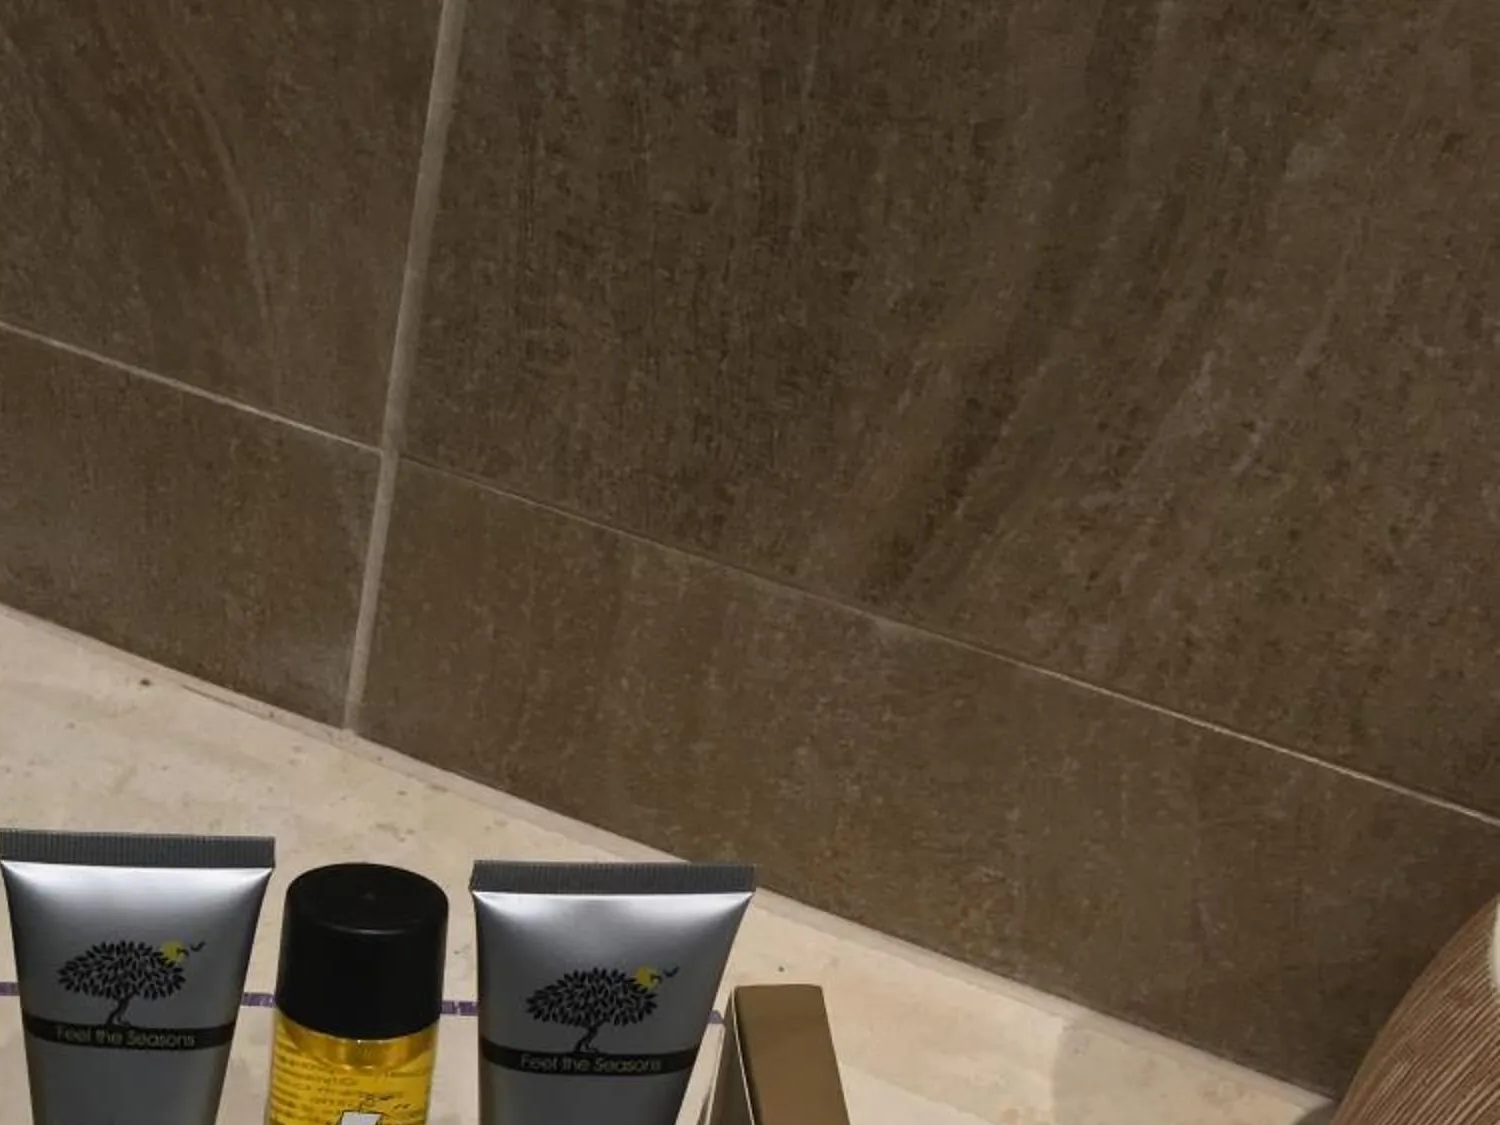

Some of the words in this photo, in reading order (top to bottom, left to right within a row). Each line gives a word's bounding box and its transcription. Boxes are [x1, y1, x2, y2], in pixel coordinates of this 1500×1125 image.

[56, 1026, 90, 1042] Feel
[95, 1028, 122, 1045] the
[127, 1029, 195, 1047] Seasons
[520, 1053, 557, 1071] Feel
[561, 1056, 590, 1072] the
[595, 1057, 661, 1073] Seasons
